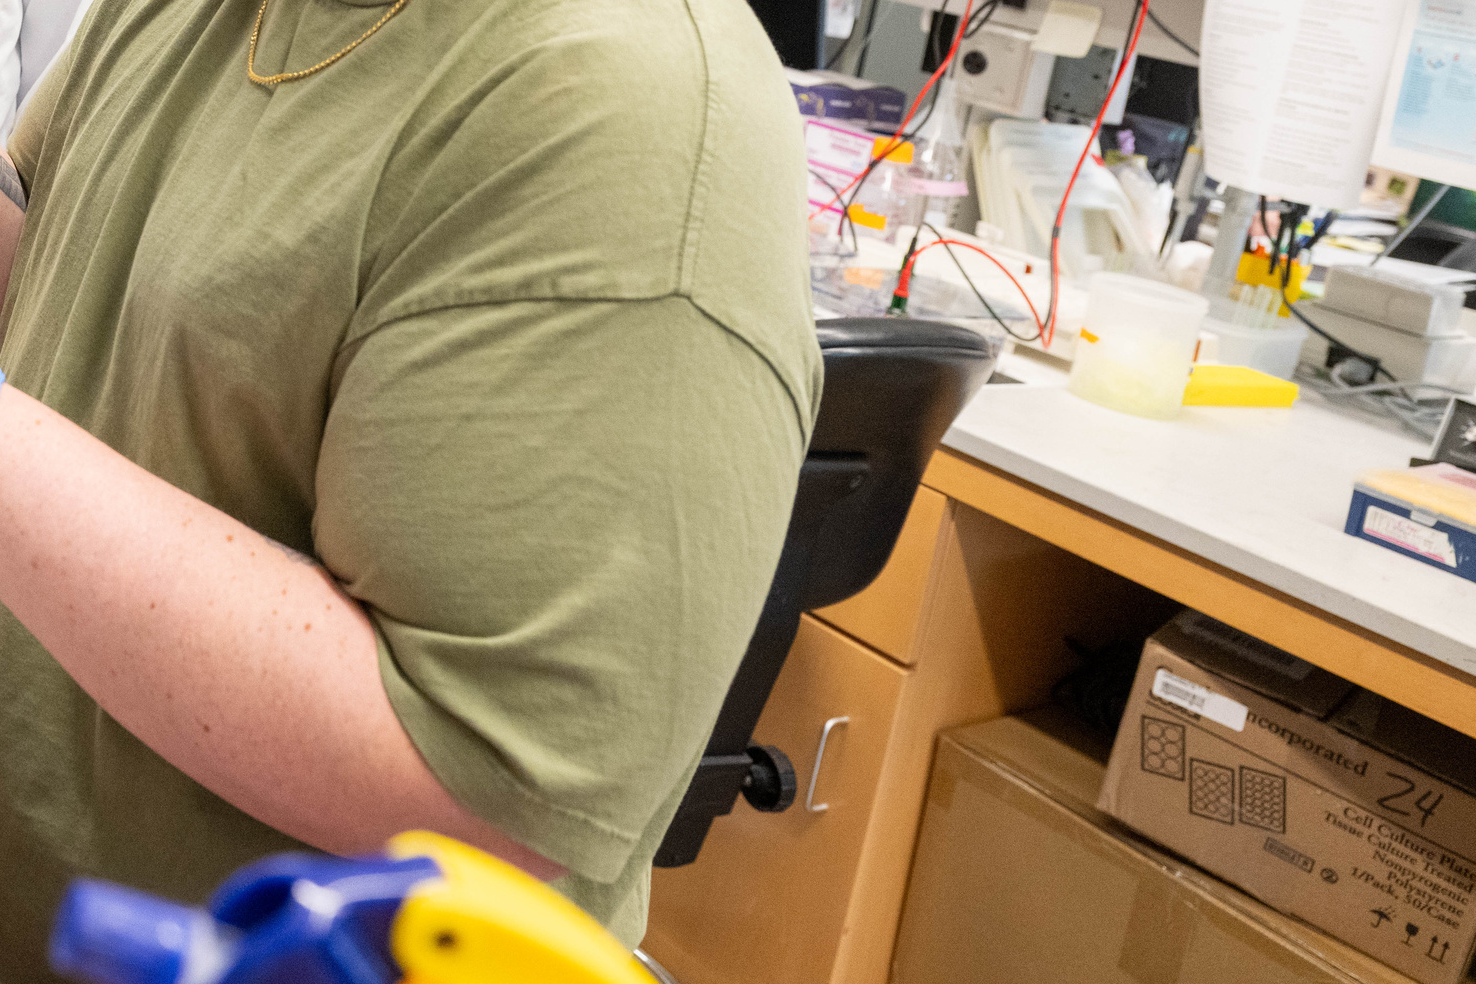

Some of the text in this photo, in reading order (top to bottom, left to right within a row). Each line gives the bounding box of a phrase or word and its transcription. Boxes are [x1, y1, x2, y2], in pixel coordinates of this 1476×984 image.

[1243, 709, 1370, 777] ncorporated
[1372, 769, 1444, 830] 24
[1325, 811, 1475, 894] Tissue Culture Treated
[1343, 805, 1374, 831] Cell
[1377, 818, 1436, 861] Culture
[1349, 866, 1399, 901] 1/Pack,
[1373, 849, 1469, 906] Nonpyrogenic
[1387, 870, 1464, 918] Polystyrene
